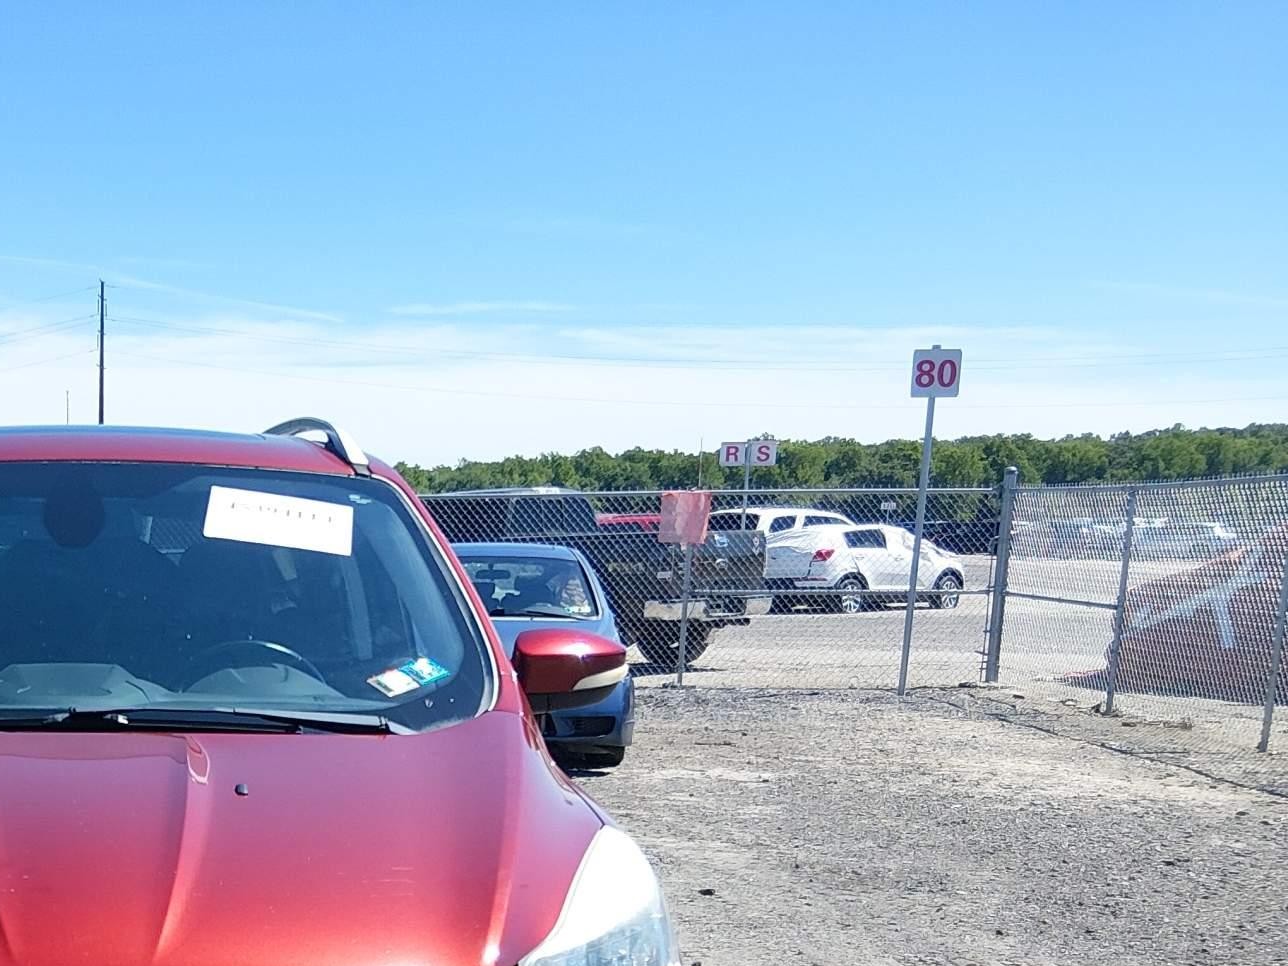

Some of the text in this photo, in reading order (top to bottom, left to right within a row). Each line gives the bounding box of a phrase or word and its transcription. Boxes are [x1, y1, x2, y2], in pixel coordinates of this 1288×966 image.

[915, 359, 957, 388] 80
[725, 445, 739, 462] R
[756, 445, 770, 462] S
